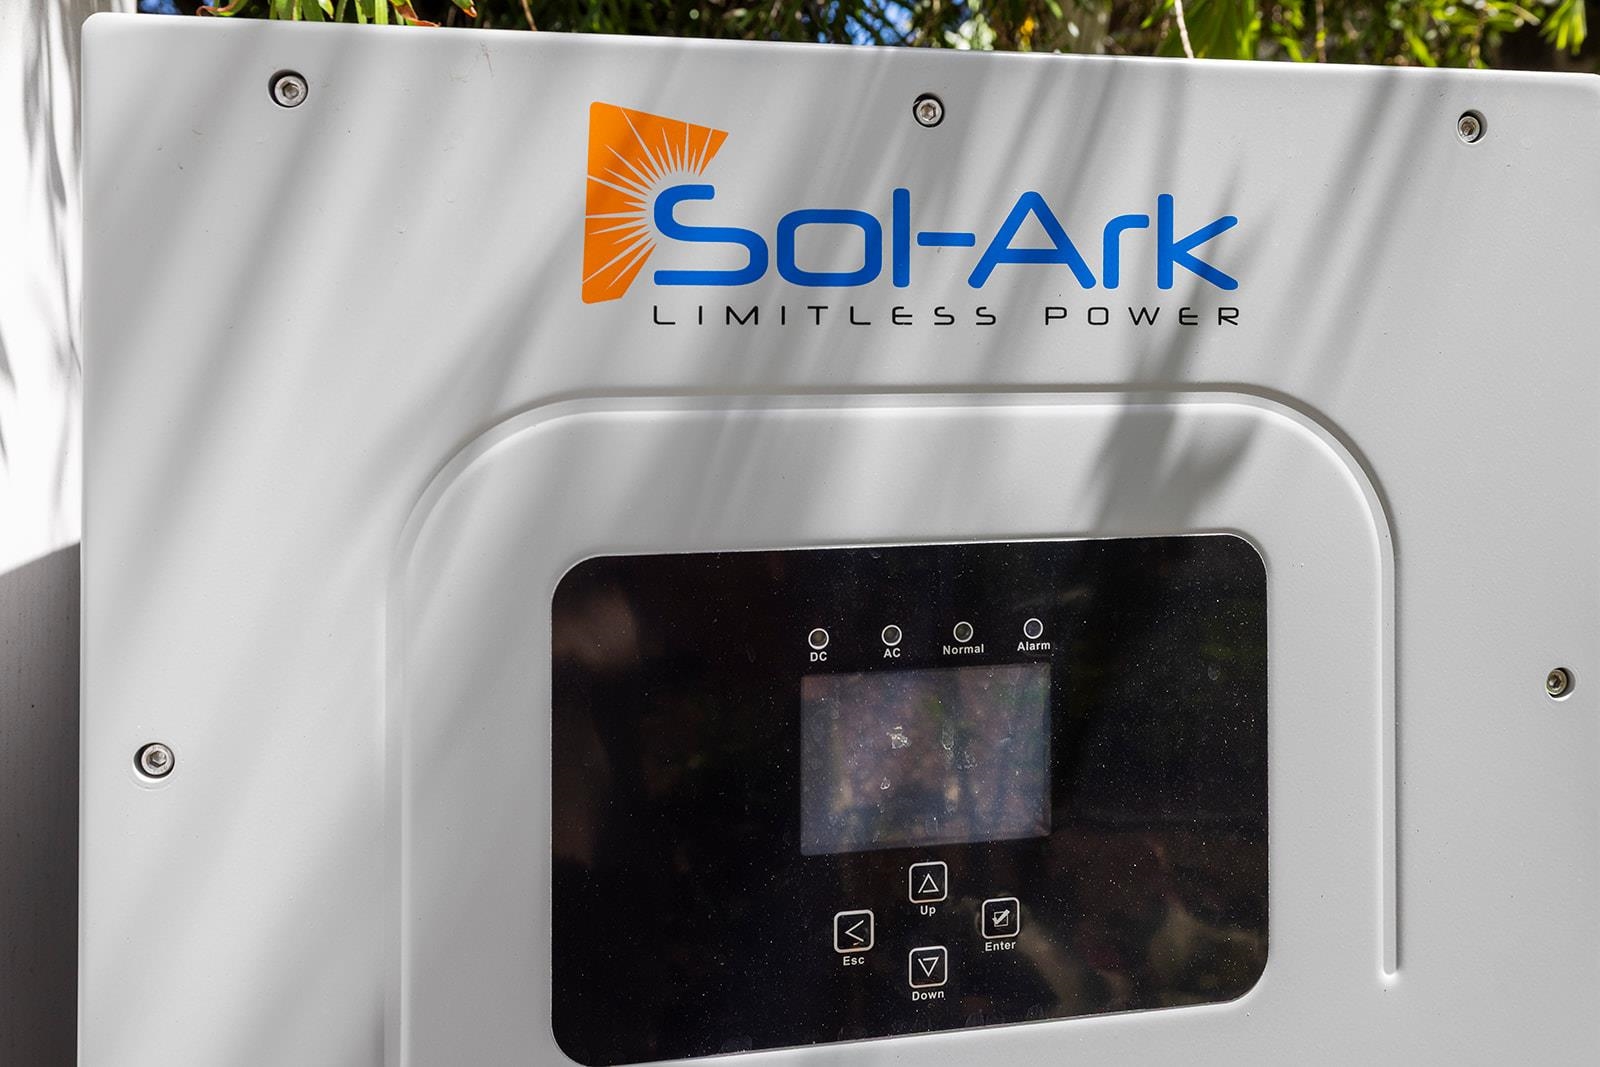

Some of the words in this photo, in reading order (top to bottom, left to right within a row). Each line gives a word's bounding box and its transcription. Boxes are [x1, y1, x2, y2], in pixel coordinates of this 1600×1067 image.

[653, 183, 1239, 290] Sol-Ark
[653, 305, 997, 326] LIMITLESS
[1045, 305, 1240, 327] POWER
[942, 643, 985, 655] Normal
[1017, 640, 1051, 652] Alarm
[810, 651, 828, 662] DC
[883, 647, 901, 658] AC
[920, 905, 937, 916] Up
[985, 940, 1016, 952] Enter
[843, 955, 865, 966] Esc
[912, 990, 945, 1001] Down
